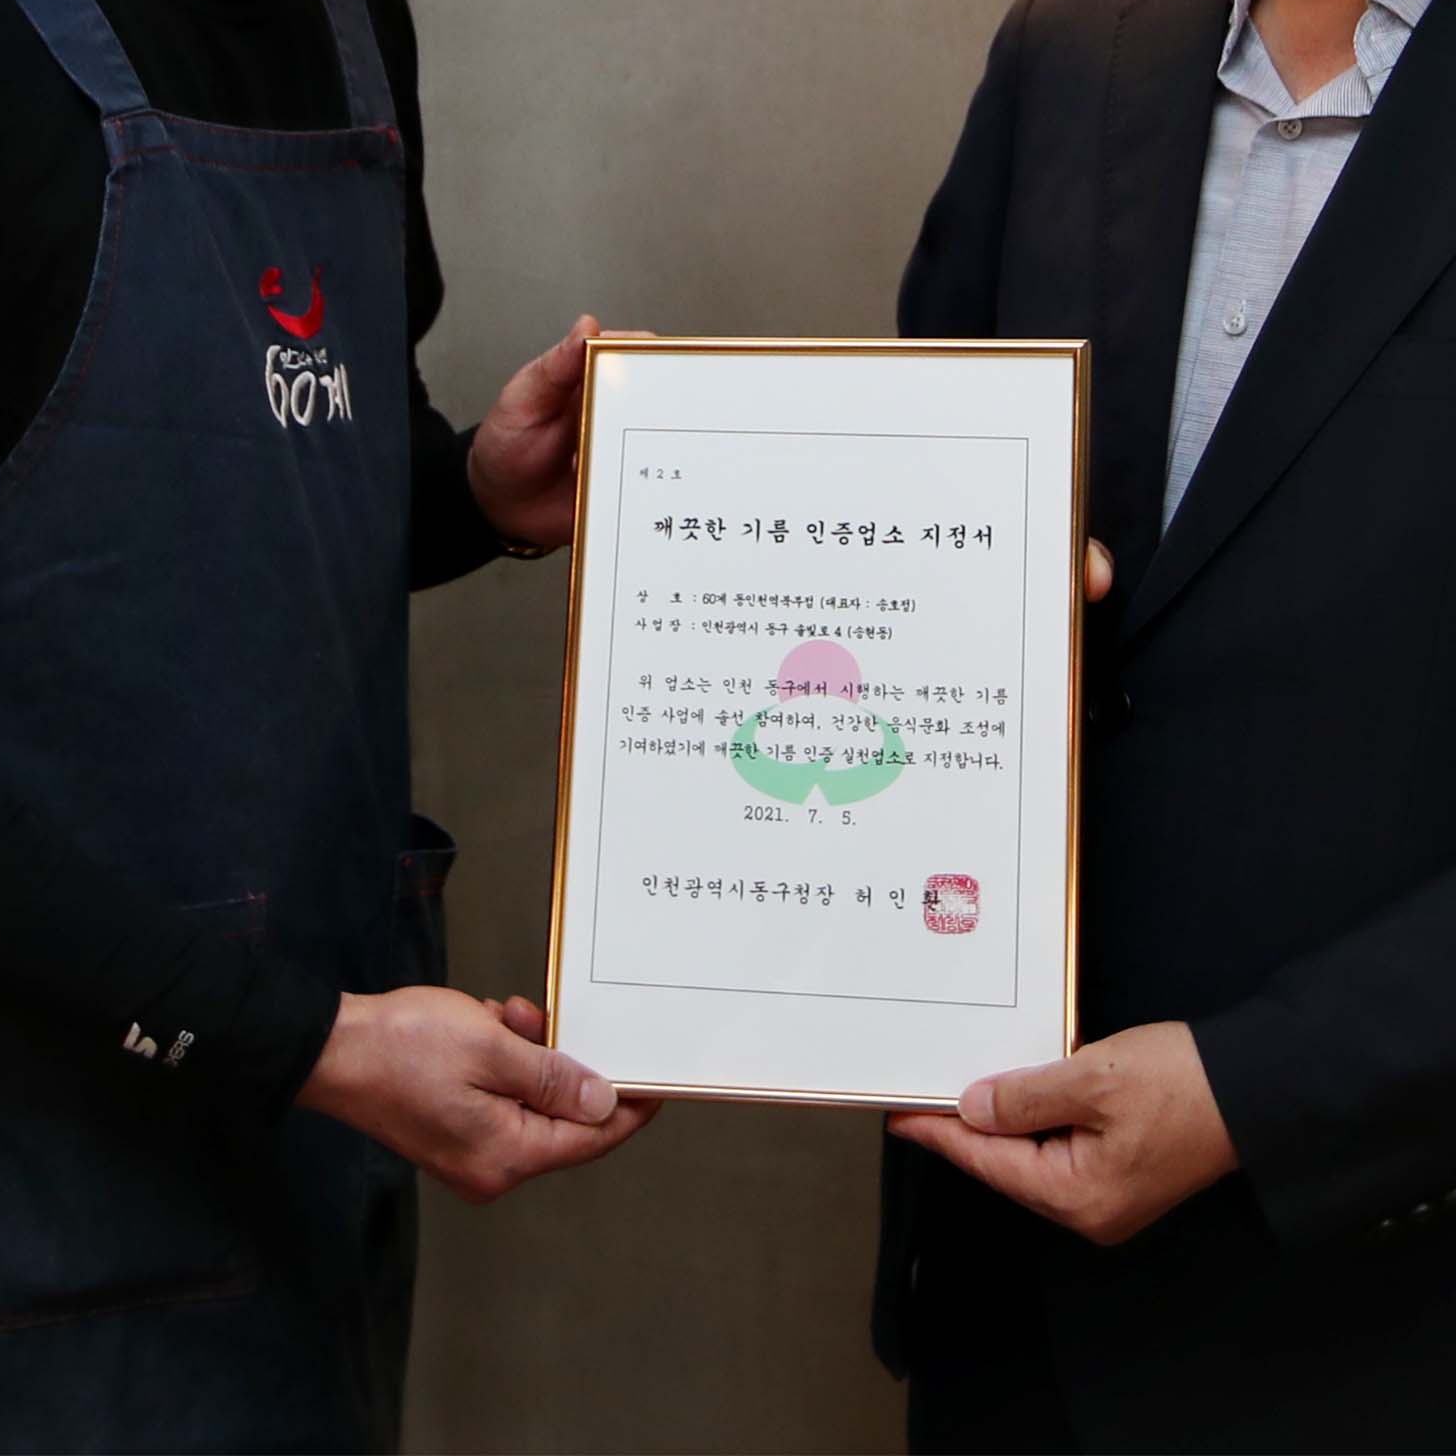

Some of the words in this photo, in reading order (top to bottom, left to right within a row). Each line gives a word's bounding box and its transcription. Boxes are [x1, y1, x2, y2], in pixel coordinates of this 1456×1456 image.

[264, 345, 353, 429] 60계
[656, 467, 665, 480] 2
[653, 515, 727, 542] 깨끗한
[740, 517, 790, 544] 기름
[806, 519, 905, 547] 인증업소
[920, 522, 993, 551] 지정서
[702, 619, 759, 636] 인천광역시
[765, 622, 789, 637] 동구
[638, 673, 653, 690] 위
[665, 675, 713, 694] 업소는
[722, 677, 752, 695] 인천
[764, 679, 828, 698] 동구에서
[839, 681, 905, 702] 시행하는
[915, 685, 965, 705] 깨끗한
[975, 687, 1009, 706] 기름
[621, 704, 652, 723] 인증
[661, 706, 705, 726] 사업에
[715, 708, 744, 727] 솔선
[831, 713, 879, 733] 건강한
[886, 716, 951, 736] 음식문화
[959, 718, 1006, 739] 조성에
[619, 736, 706, 758] 기여하였기에
[713, 741, 761, 760] 깨끗한
[766, 743, 797, 763] 기름
[803, 745, 835, 764] 인증
[843, 746, 917, 767] 실천업소로
[924, 750, 1004, 772] 지정합니다.
[743, 805, 790, 823] 2021.
[807, 808, 824, 825] 7.
[841, 810, 857, 826] 5.
[642, 874, 836, 907] 인천광역시동구청장
